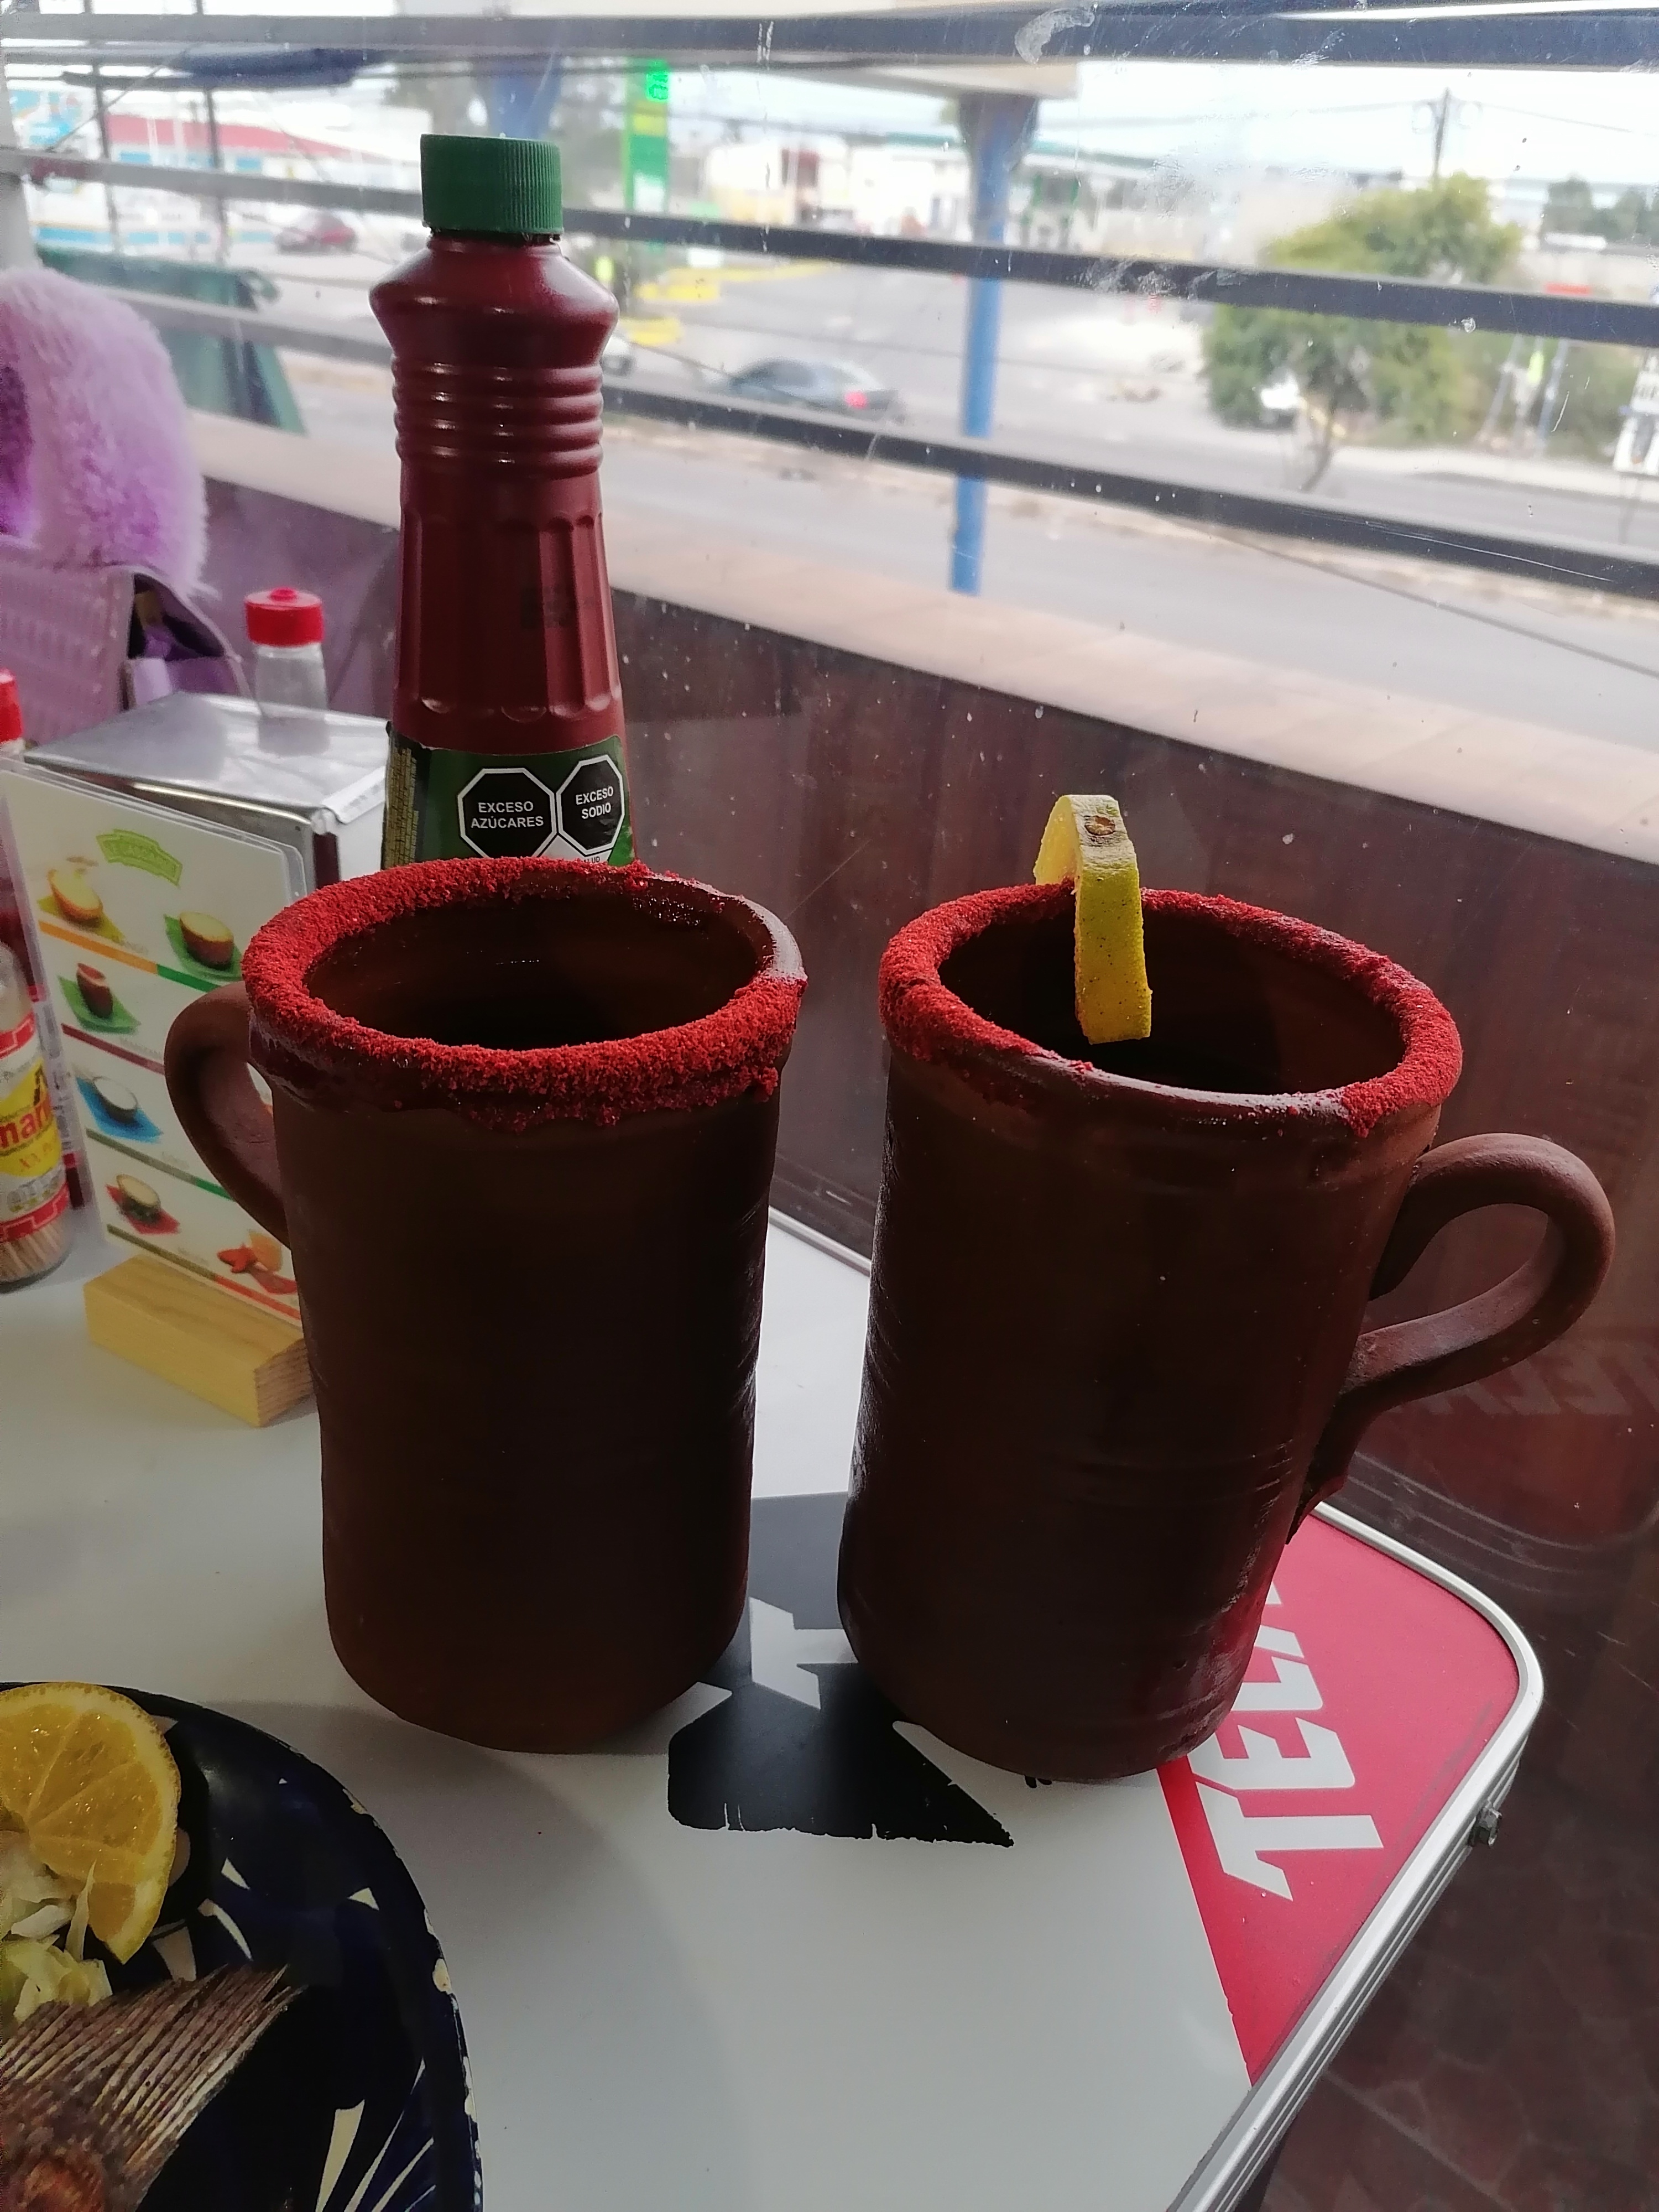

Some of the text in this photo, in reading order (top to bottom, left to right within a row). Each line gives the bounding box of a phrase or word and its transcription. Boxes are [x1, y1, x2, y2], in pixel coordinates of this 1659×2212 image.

[576, 786, 614, 805] EXCESO
[478, 801, 534, 813] EXCESO
[581, 802, 612, 820] SODIO
[471, 816, 544, 828] AZÚCARES
